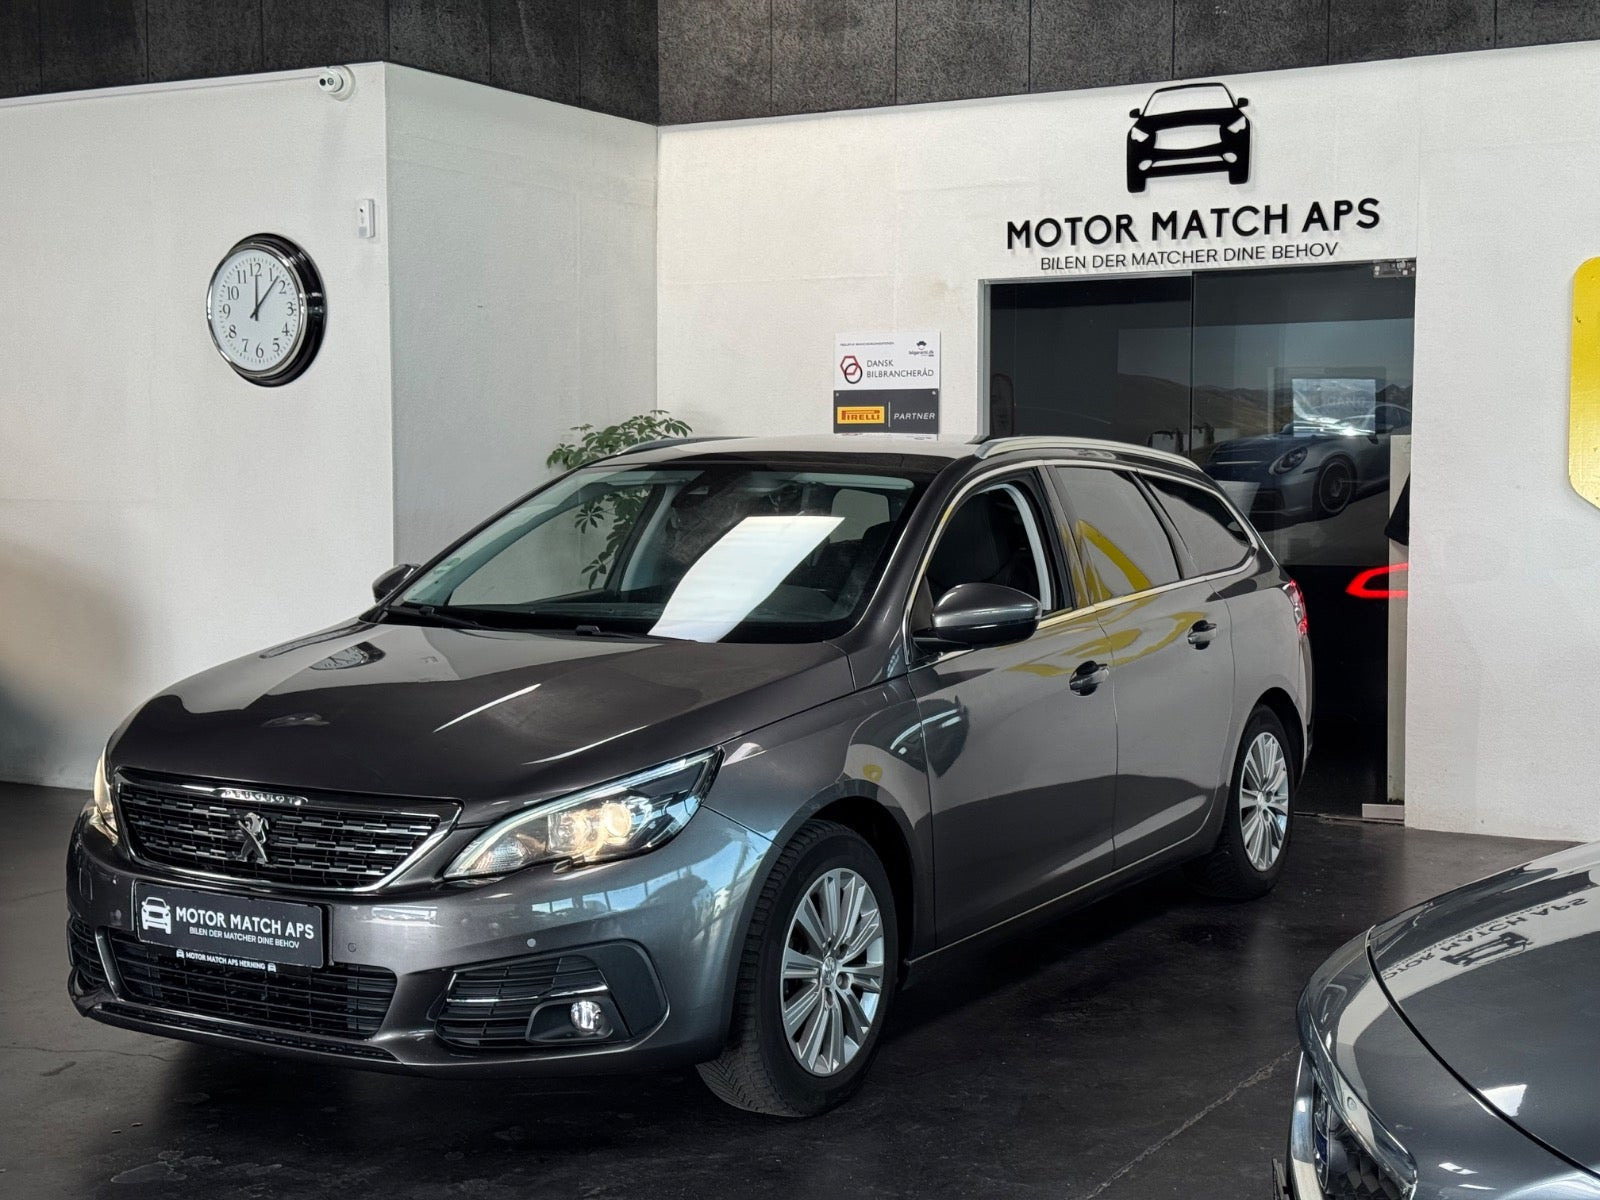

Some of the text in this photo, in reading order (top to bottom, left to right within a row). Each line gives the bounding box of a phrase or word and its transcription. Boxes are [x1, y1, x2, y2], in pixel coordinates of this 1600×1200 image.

[1007, 197, 1380, 250] MOTOR MATCH APS
[1041, 242, 1339, 271] BILEN DER MATCHER DINE BEHOV
[237, 269, 247, 284] 11
[250, 262, 262, 277] 12
[269, 267, 273, 281] 1
[227, 286, 240, 300] 10
[279, 280, 287, 294] 2
[222, 303, 231, 318] 9
[287, 301, 294, 316] 3
[228, 324, 237, 339] 8
[281, 322, 290, 336] 4
[241, 338, 249, 352] 7
[255, 343, 264, 359] 6
[272, 337, 280, 352] 5
[866, 359, 894, 368] DANSK
[866, 368, 934, 378] BILBRANCHERÅD
[841, 409, 881, 421] PIRELLI
[894, 412, 936, 421] PARTNER
[175, 906, 315, 940] MOTOR MATCH APS
[189, 926, 300, 949] BILEN DER MATCHER DINE BEHOV
[185, 951, 206, 961] MOTOR
[206, 955, 227, 965] MATCH
[227, 958, 239, 967] APS
